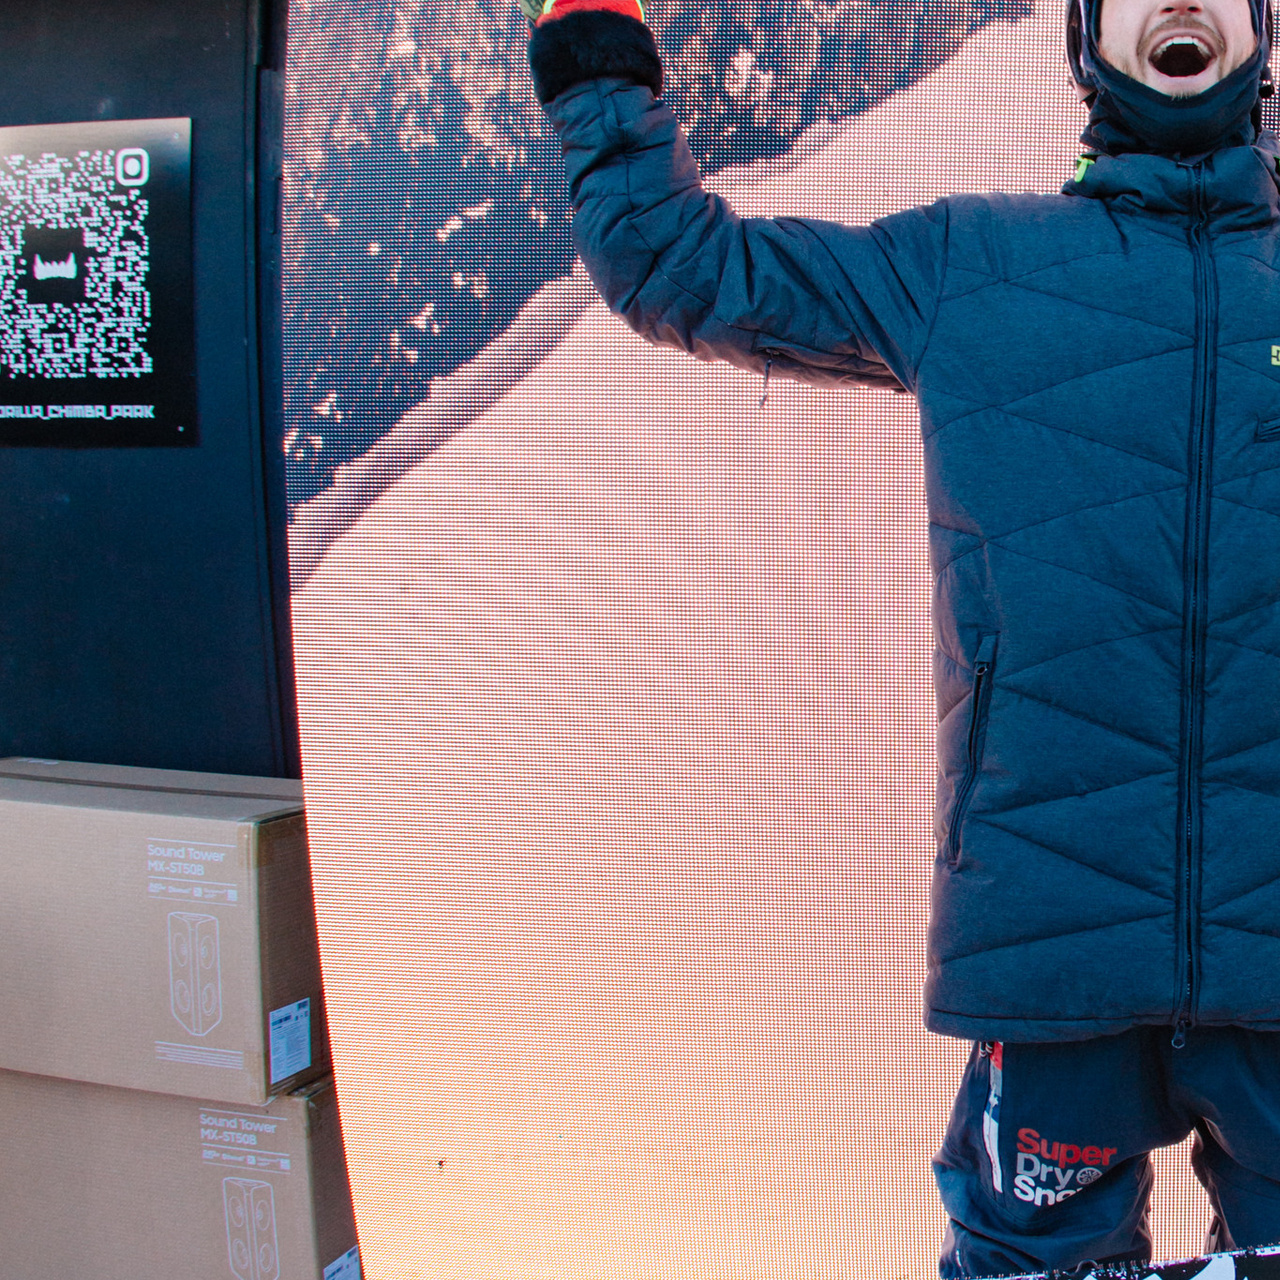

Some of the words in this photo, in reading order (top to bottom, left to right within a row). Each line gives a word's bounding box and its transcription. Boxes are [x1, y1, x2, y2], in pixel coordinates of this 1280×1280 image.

[147, 843, 186, 859] Sound
[186, 847, 226, 862] Tower
[199, 1113, 238, 1129] Sound
[238, 1118, 277, 1134] Tower
[1016, 1127, 1118, 1169] Super
[1016, 1152, 1075, 1191] Dry
[1013, 1174, 1083, 1207] Sno
